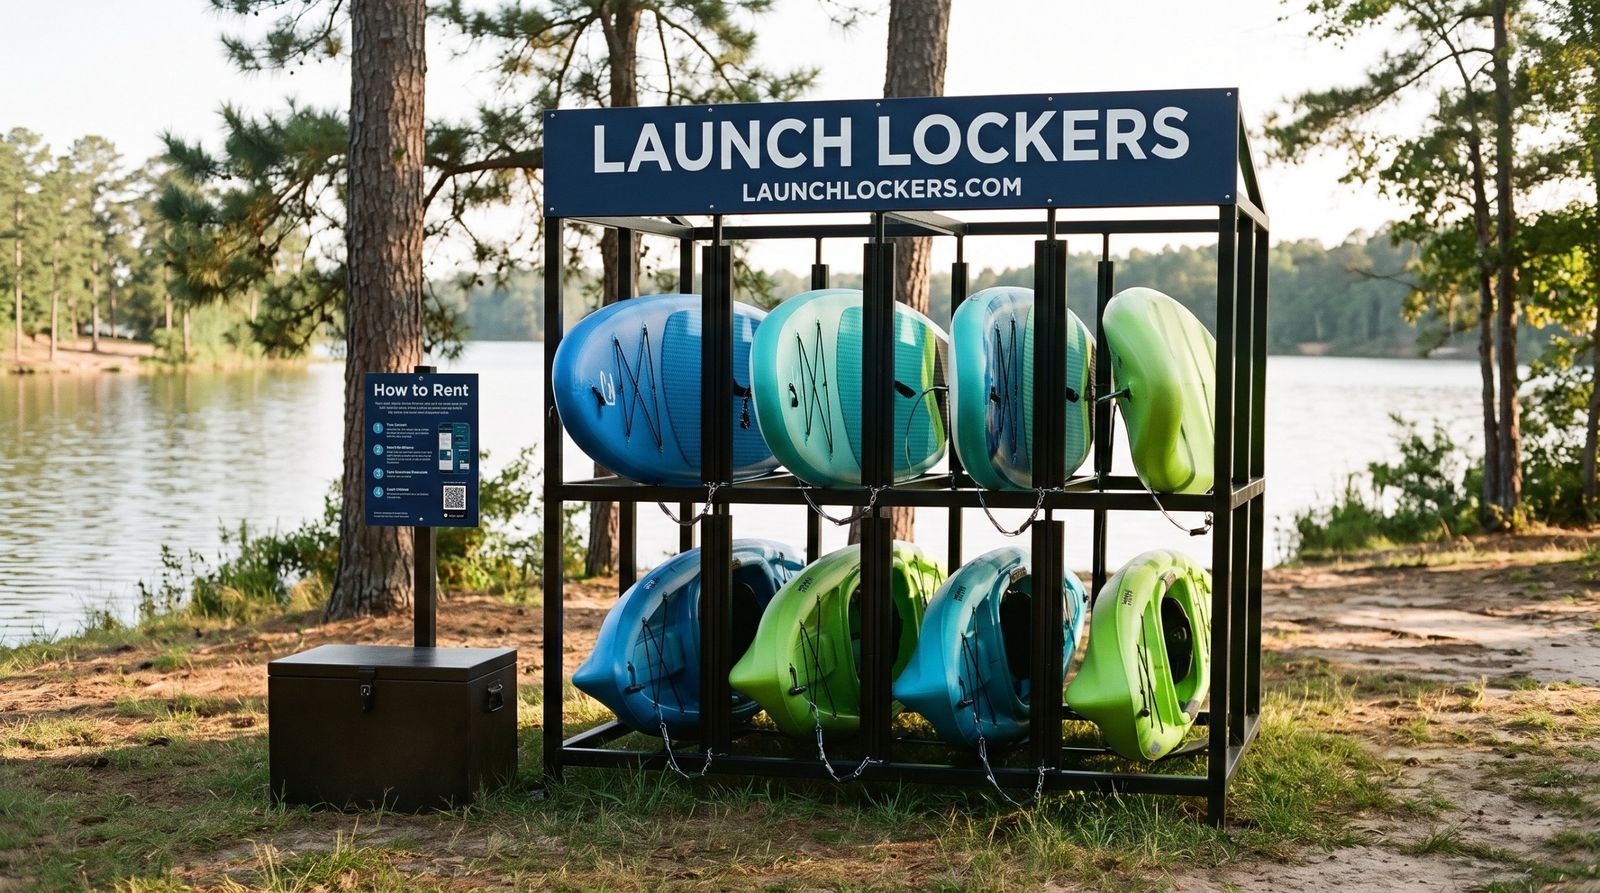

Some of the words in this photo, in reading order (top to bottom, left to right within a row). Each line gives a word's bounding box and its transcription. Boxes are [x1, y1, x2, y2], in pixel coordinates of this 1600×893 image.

[595, 117, 851, 173] LAUNCH
[879, 107, 1189, 165] LOCKERS
[743, 178, 1021, 201] LAUNCHLOCKERS.COM
[375, 384, 407, 396] How
[412, 384, 428, 396] to
[434, 384, 468, 396] Rent
